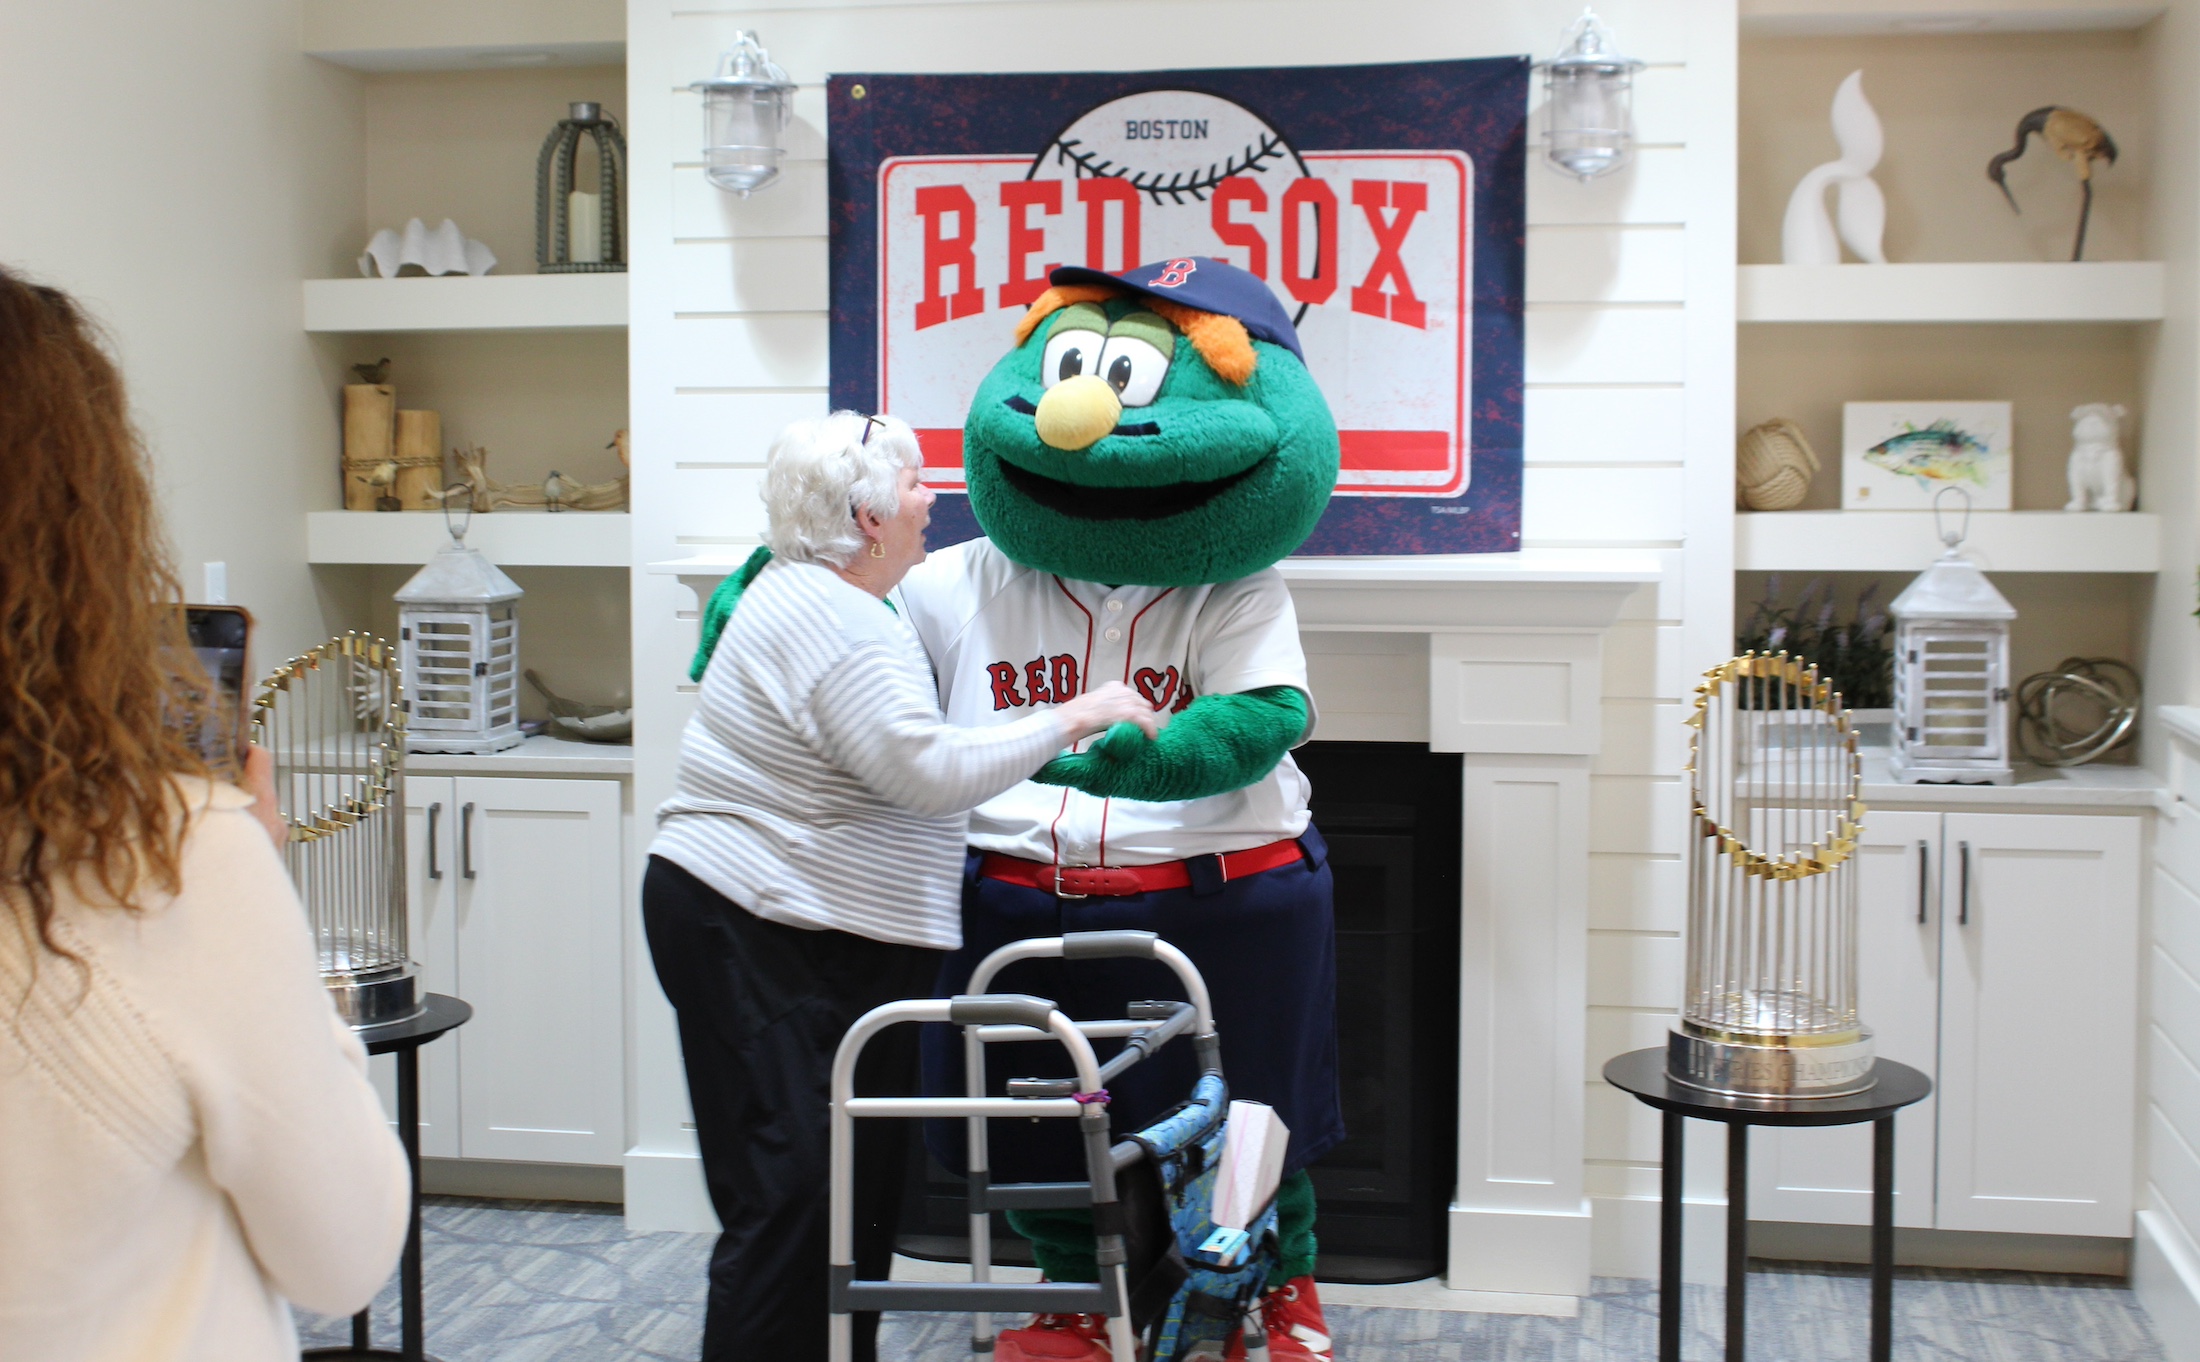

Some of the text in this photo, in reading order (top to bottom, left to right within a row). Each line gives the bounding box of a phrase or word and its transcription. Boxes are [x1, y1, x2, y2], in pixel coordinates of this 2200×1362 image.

[1125, 118, 1209, 140] BOSTON
[914, 175, 1429, 331] RED SOX
[1147, 257, 1198, 288] B
[985, 652, 1081, 712] RED
